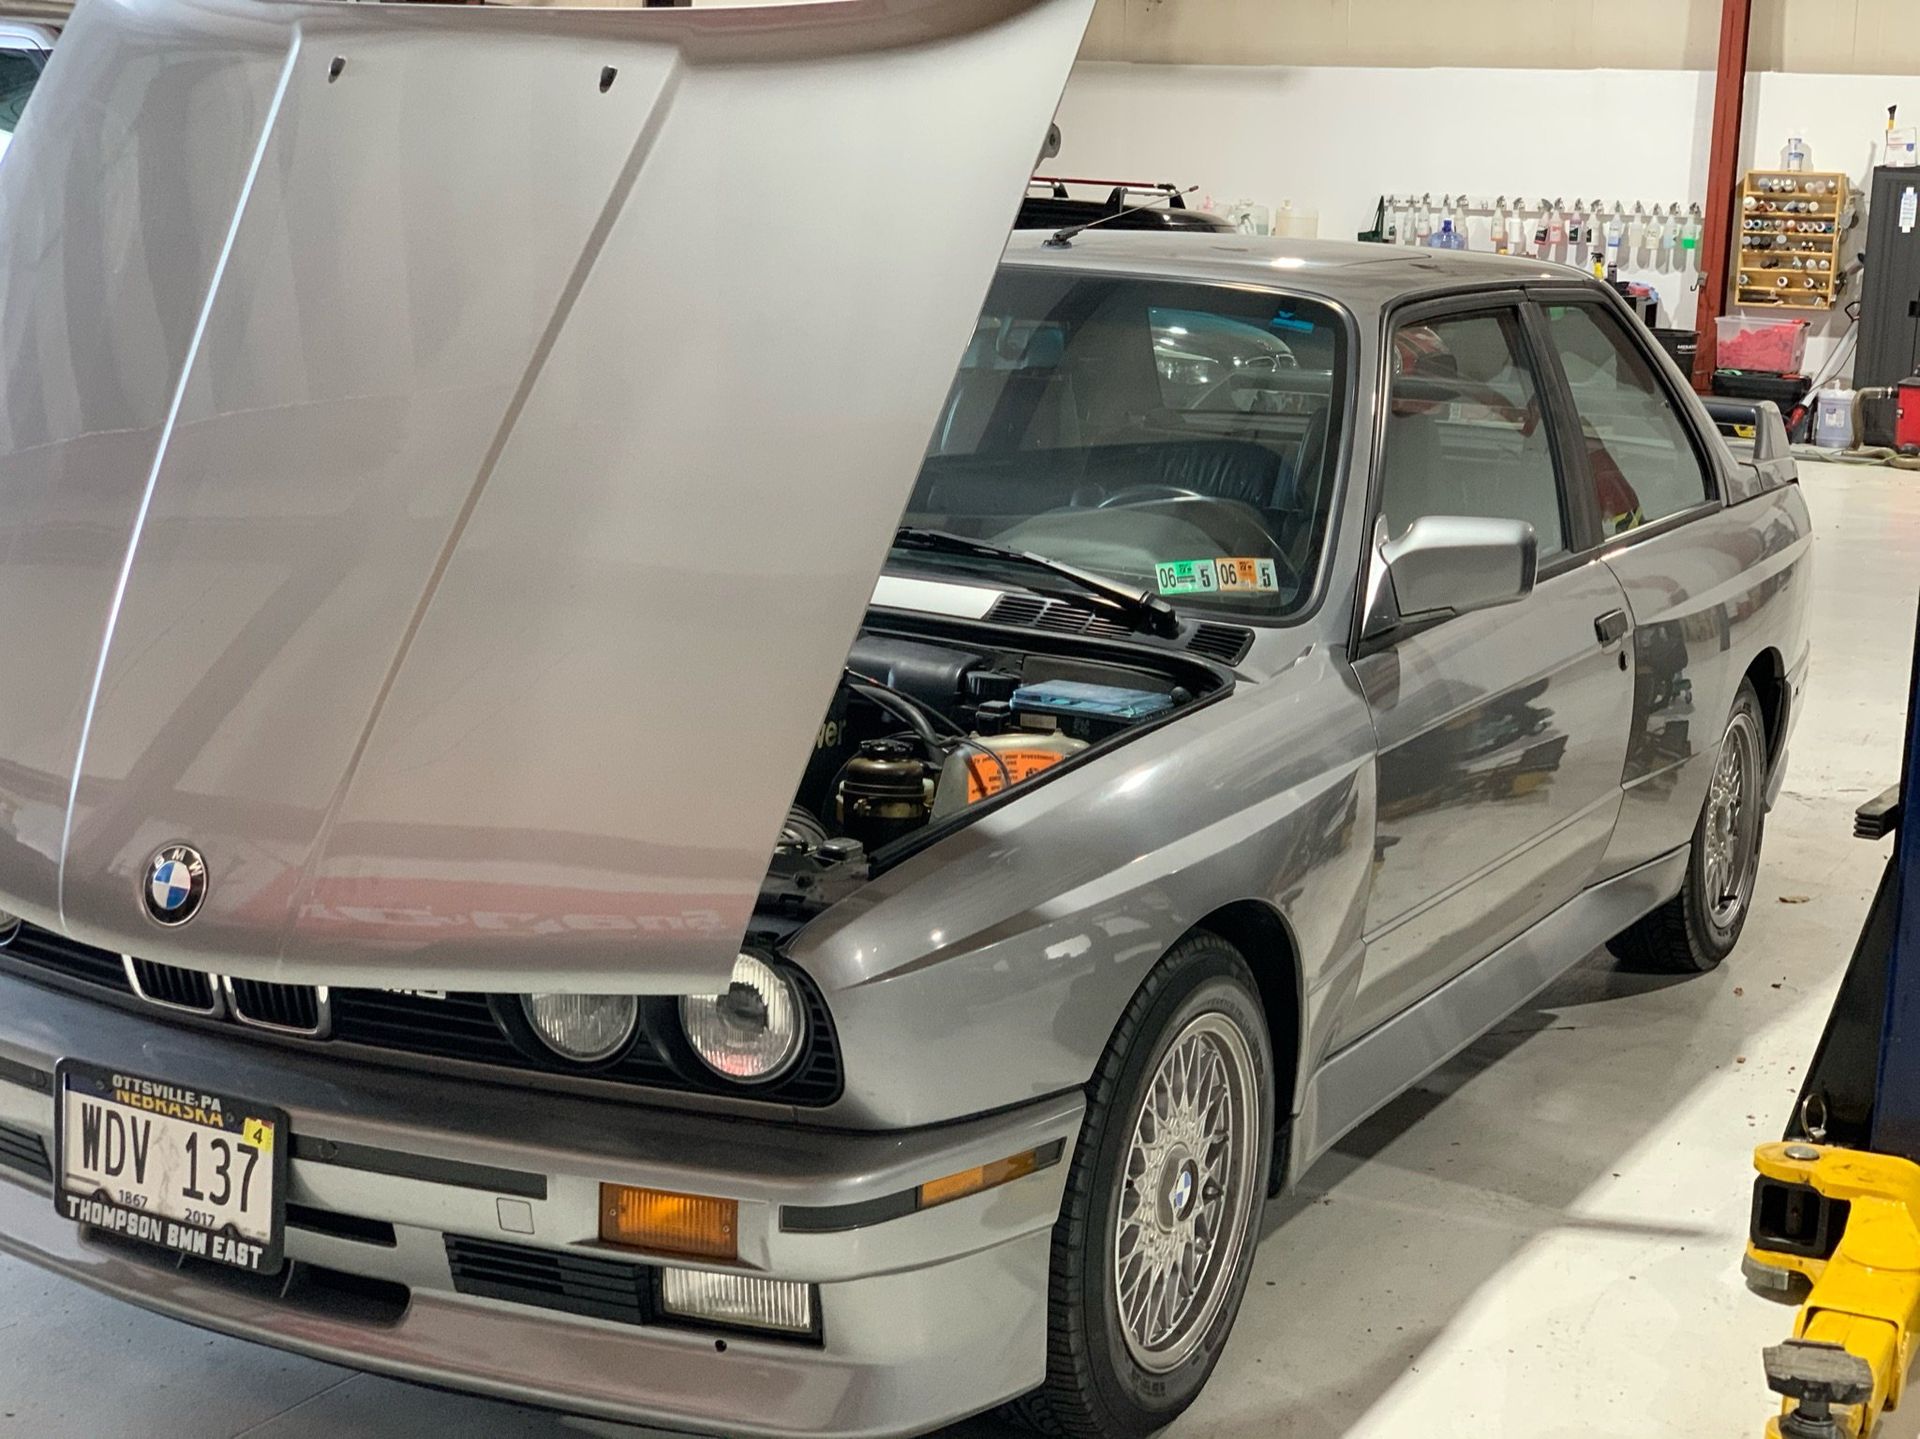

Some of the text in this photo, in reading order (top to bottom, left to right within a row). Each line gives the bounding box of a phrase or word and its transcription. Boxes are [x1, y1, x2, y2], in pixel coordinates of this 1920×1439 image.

[1159, 567, 1177, 588] 06
[1200, 568, 1211, 588] 5
[1219, 563, 1237, 584] 06
[1261, 567, 1271, 587] 5
[153, 848, 203, 877] BMW
[115, 1090, 223, 1127] NEBRASKA
[252, 1127, 263, 1144] 4
[82, 1102, 259, 1212] WDV 137
[118, 1189, 148, 1207] 1867
[184, 1208, 216, 1227] 2017
[67, 1196, 263, 1270] THOMPSON BMW EAST
